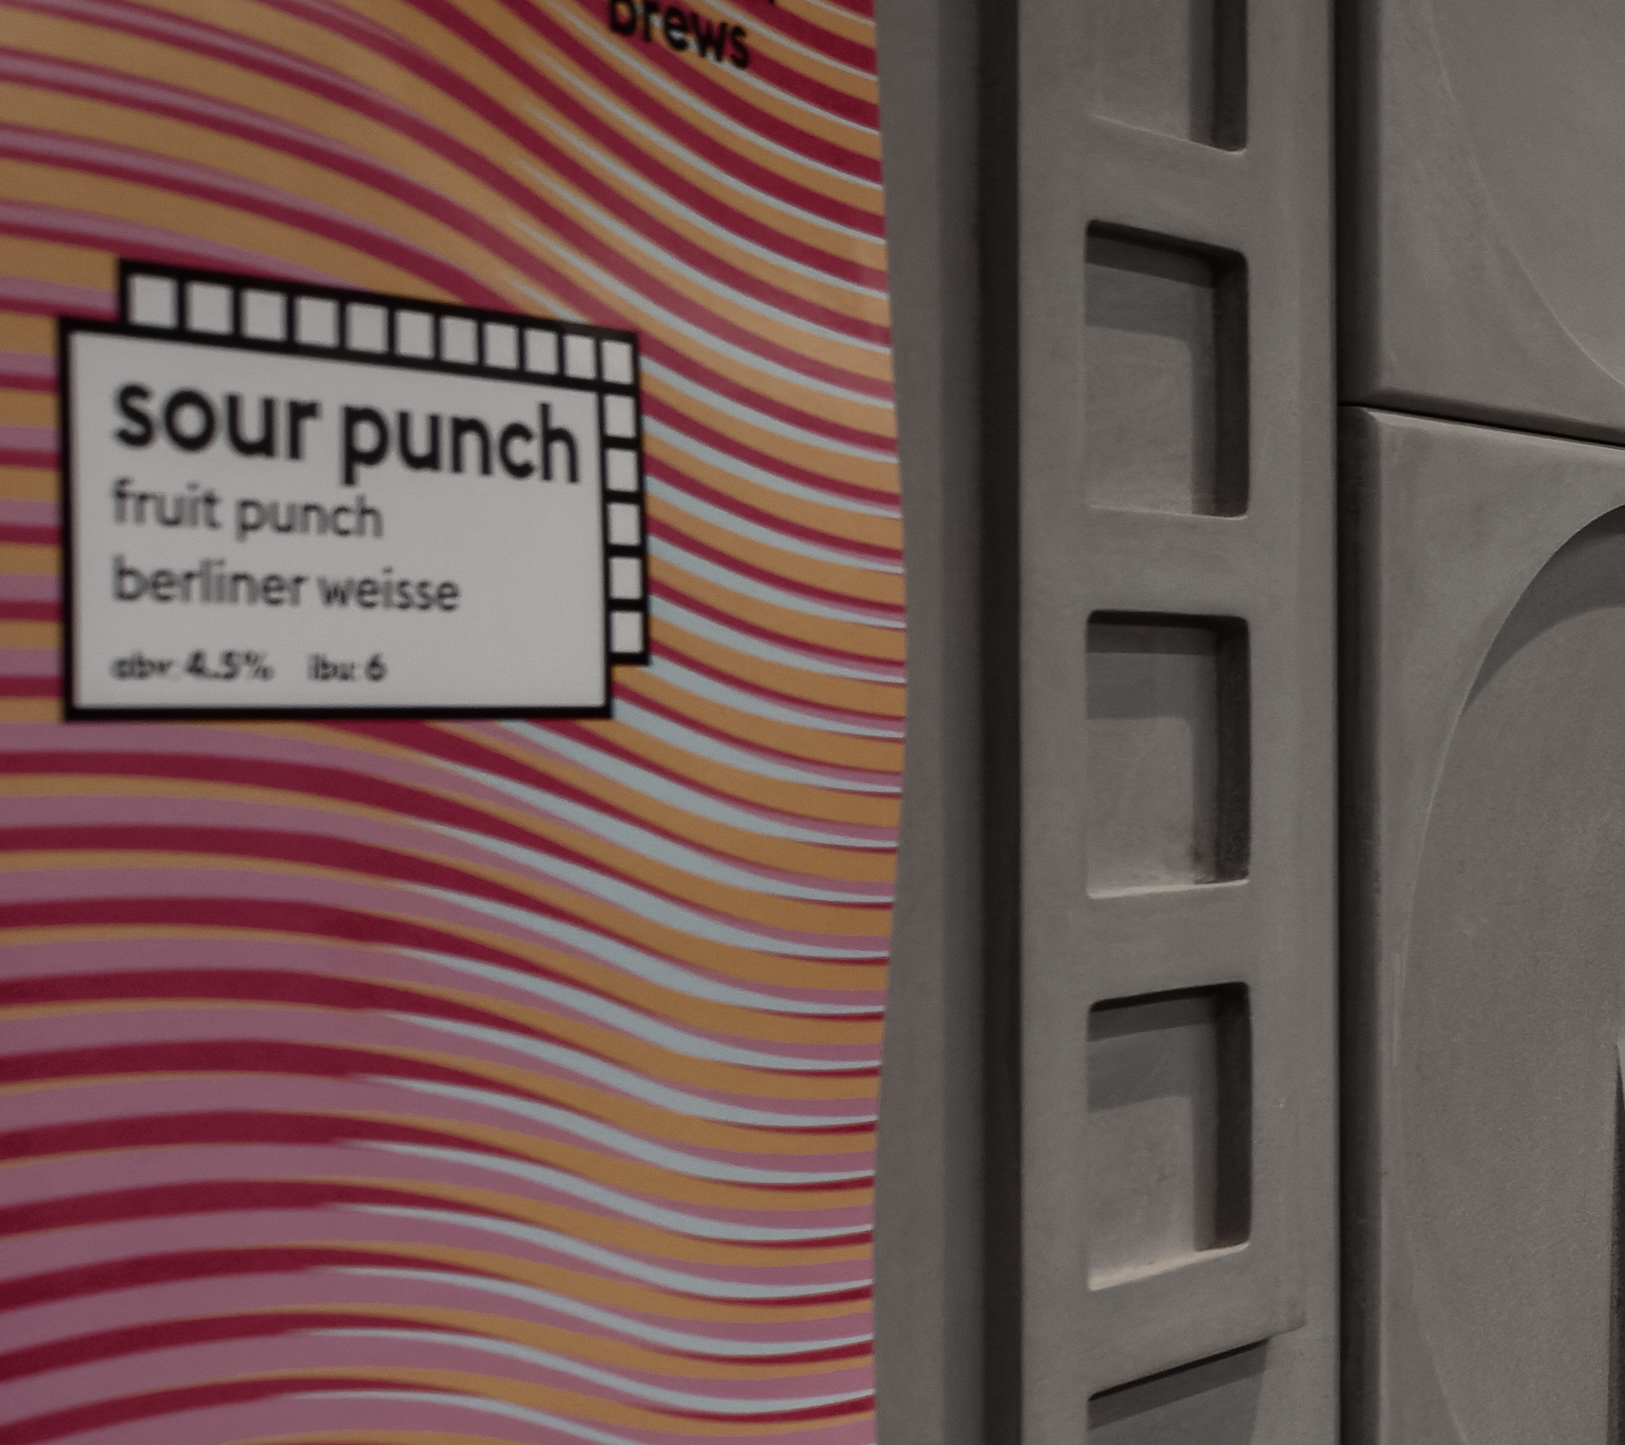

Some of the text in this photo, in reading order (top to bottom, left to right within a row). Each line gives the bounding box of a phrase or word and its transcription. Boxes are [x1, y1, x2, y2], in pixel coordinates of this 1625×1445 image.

[114, 382, 580, 485] sour punch
[112, 477, 383, 540] fruit punch
[112, 555, 461, 611] berliner weisse
[364, 653, 387, 681] 6
